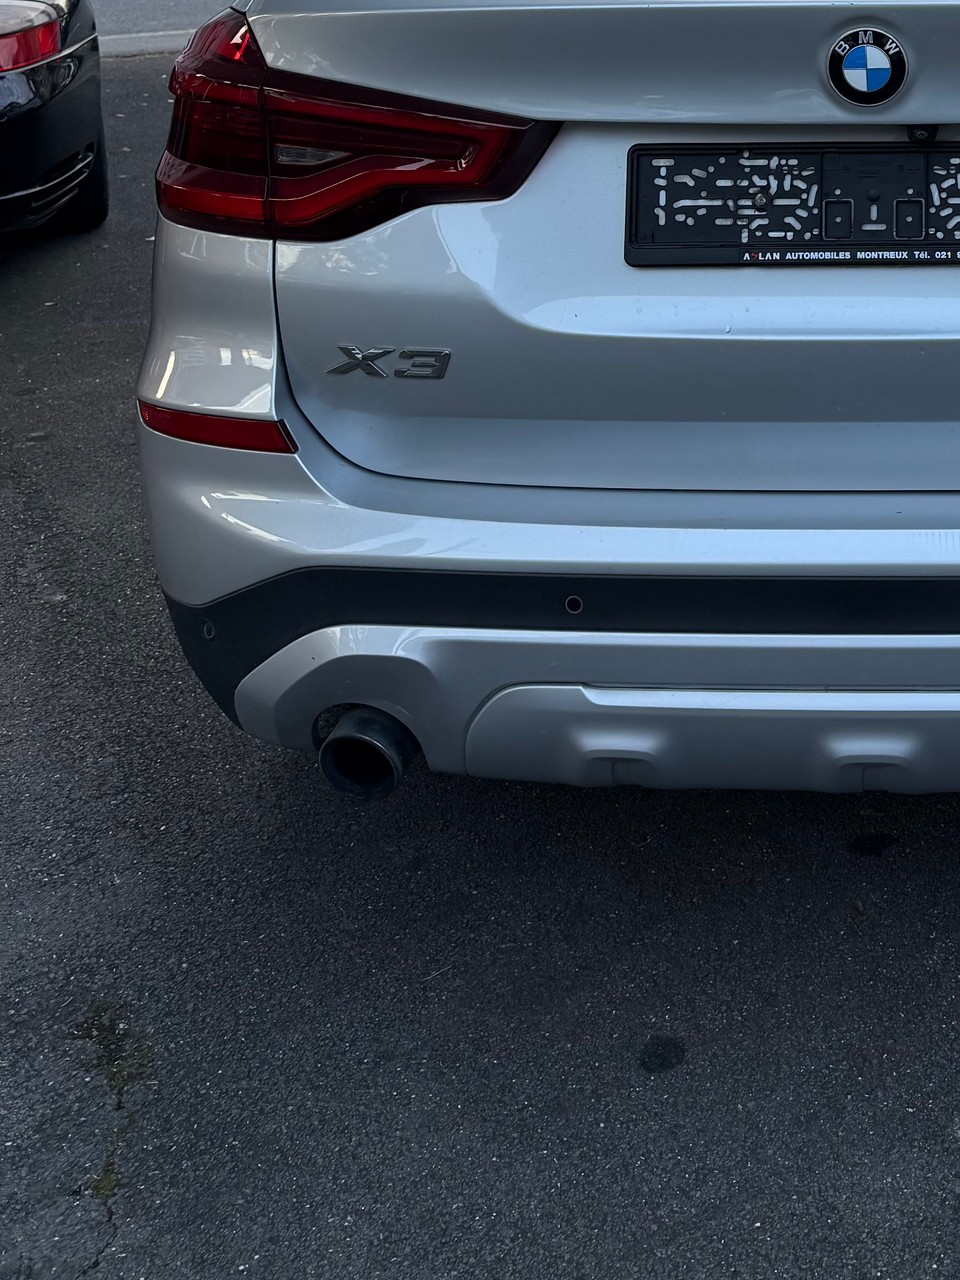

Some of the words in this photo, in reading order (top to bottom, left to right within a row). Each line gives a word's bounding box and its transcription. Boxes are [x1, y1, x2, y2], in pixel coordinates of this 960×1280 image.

[834, 30, 900, 57] BMW
[785, 251, 851, 260] AUTOMOBILES
[857, 251, 908, 260] MONTREUX
[914, 250, 931, 259] Tél.
[935, 251, 951, 259] 021
[324, 343, 451, 380] X3
